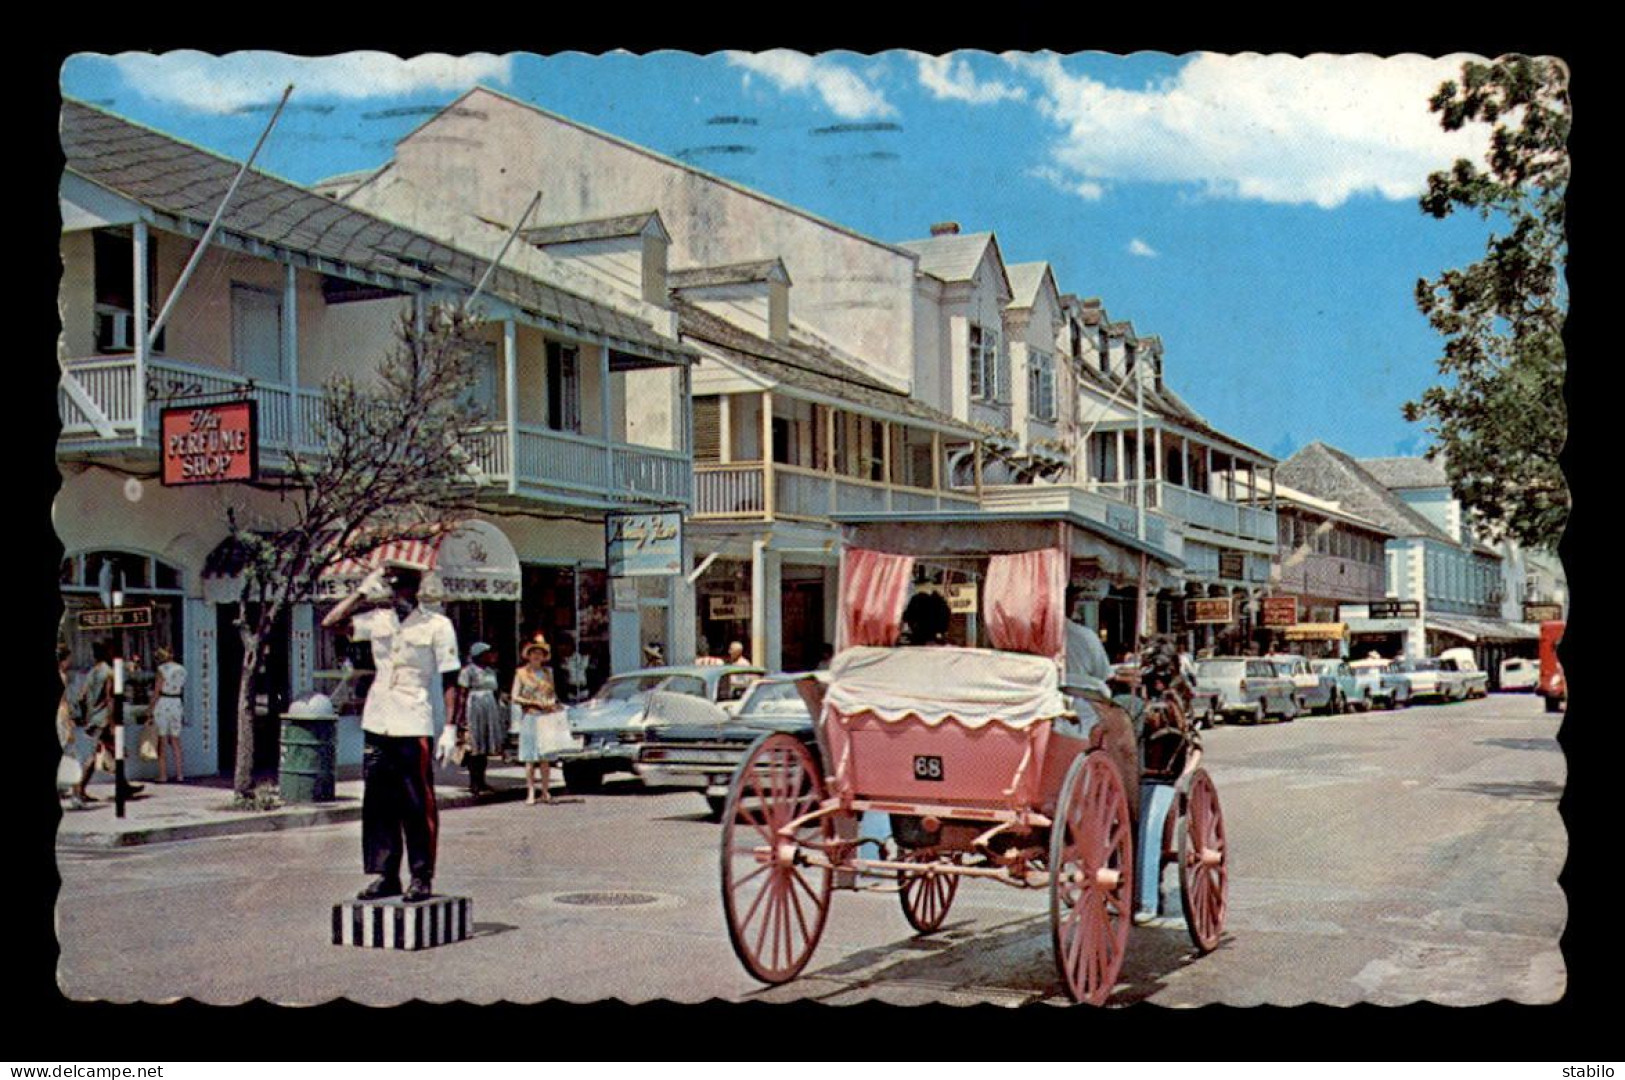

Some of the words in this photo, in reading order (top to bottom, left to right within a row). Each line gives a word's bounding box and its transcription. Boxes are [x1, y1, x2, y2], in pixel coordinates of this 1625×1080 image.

[189, 409, 221, 431] The
[167, 429, 245, 458] PERFUME
[182, 454, 232, 479] SHOP
[270, 578, 338, 597] PUME
[441, 576, 488, 593] PERFUME
[915, 757, 941, 777] 68
